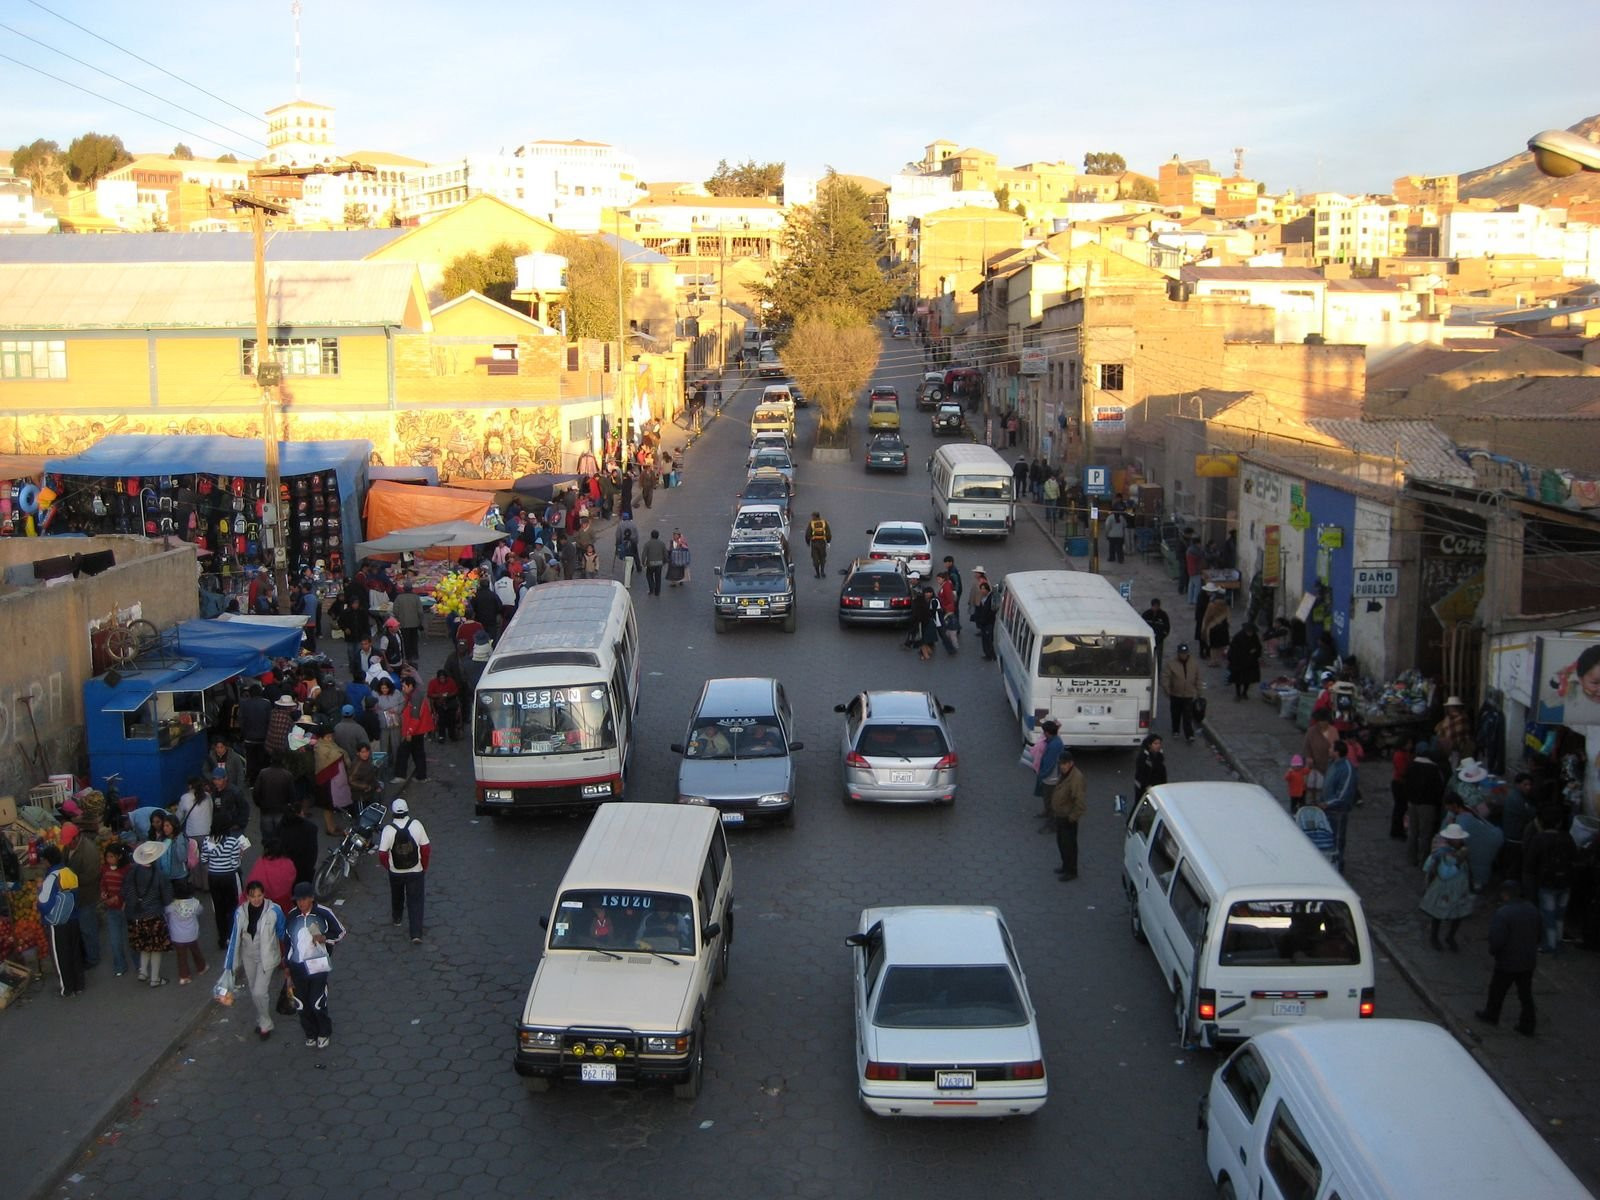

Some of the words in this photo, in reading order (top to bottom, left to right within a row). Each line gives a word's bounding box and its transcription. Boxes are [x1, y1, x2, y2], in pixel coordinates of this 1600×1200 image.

[1094, 471, 1100, 483] P
[502, 687, 581, 706] NISSAN
[602, 895, 651, 908] ISUZU
[582, 1069, 597, 1079] 962
